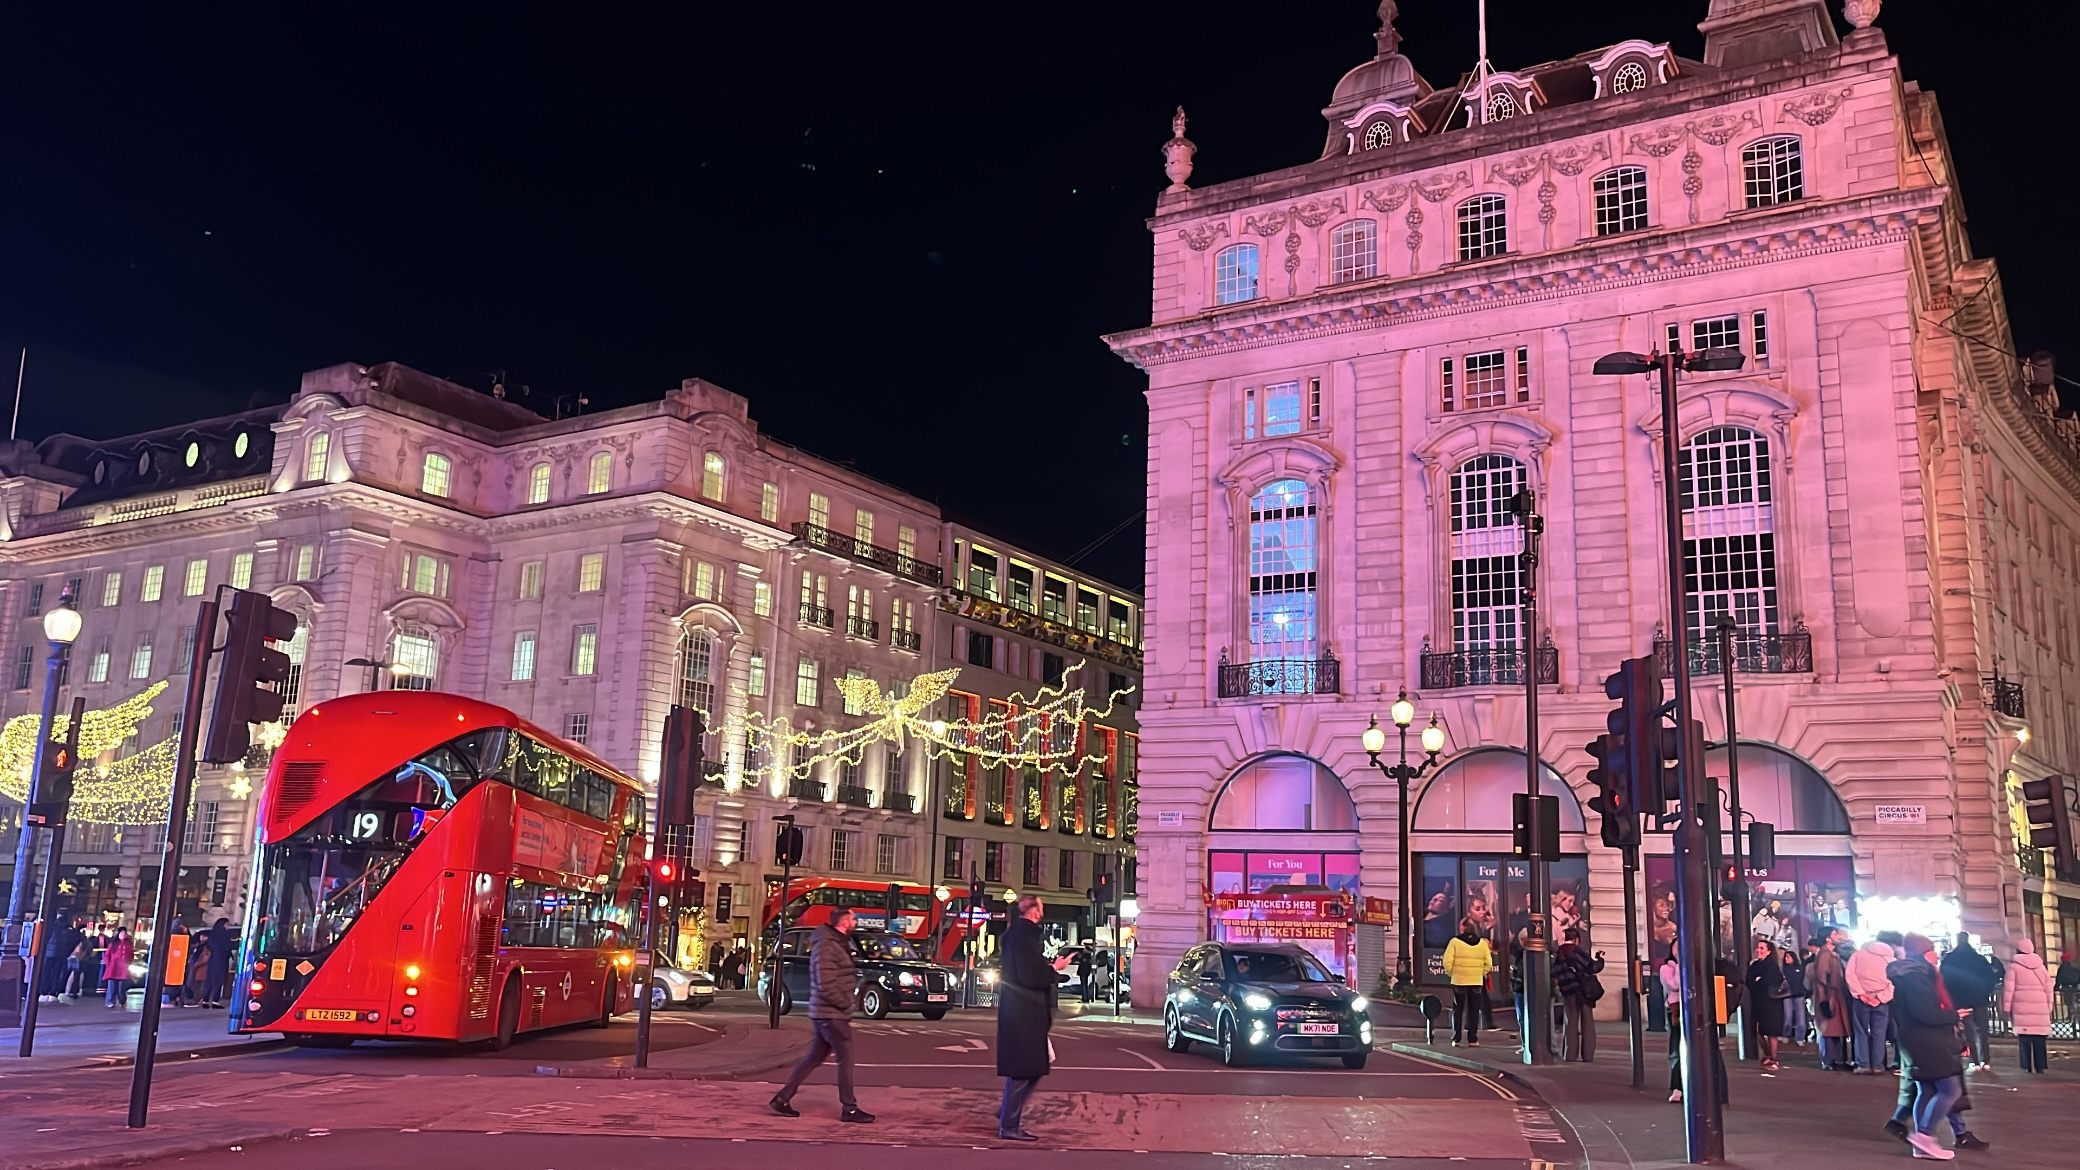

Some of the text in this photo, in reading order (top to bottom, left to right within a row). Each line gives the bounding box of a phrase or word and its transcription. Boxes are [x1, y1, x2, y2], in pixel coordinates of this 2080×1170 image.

[352, 812, 379, 838] 19
[1268, 859, 1303, 869] For You
[1479, 866, 1525, 877] For Me
[1237, 899, 1254, 908] BUY
[1255, 899, 1292, 909] TICKETS
[1293, 901, 1317, 910] HERE
[1235, 927, 1336, 938] BUY TICKETS HERE
